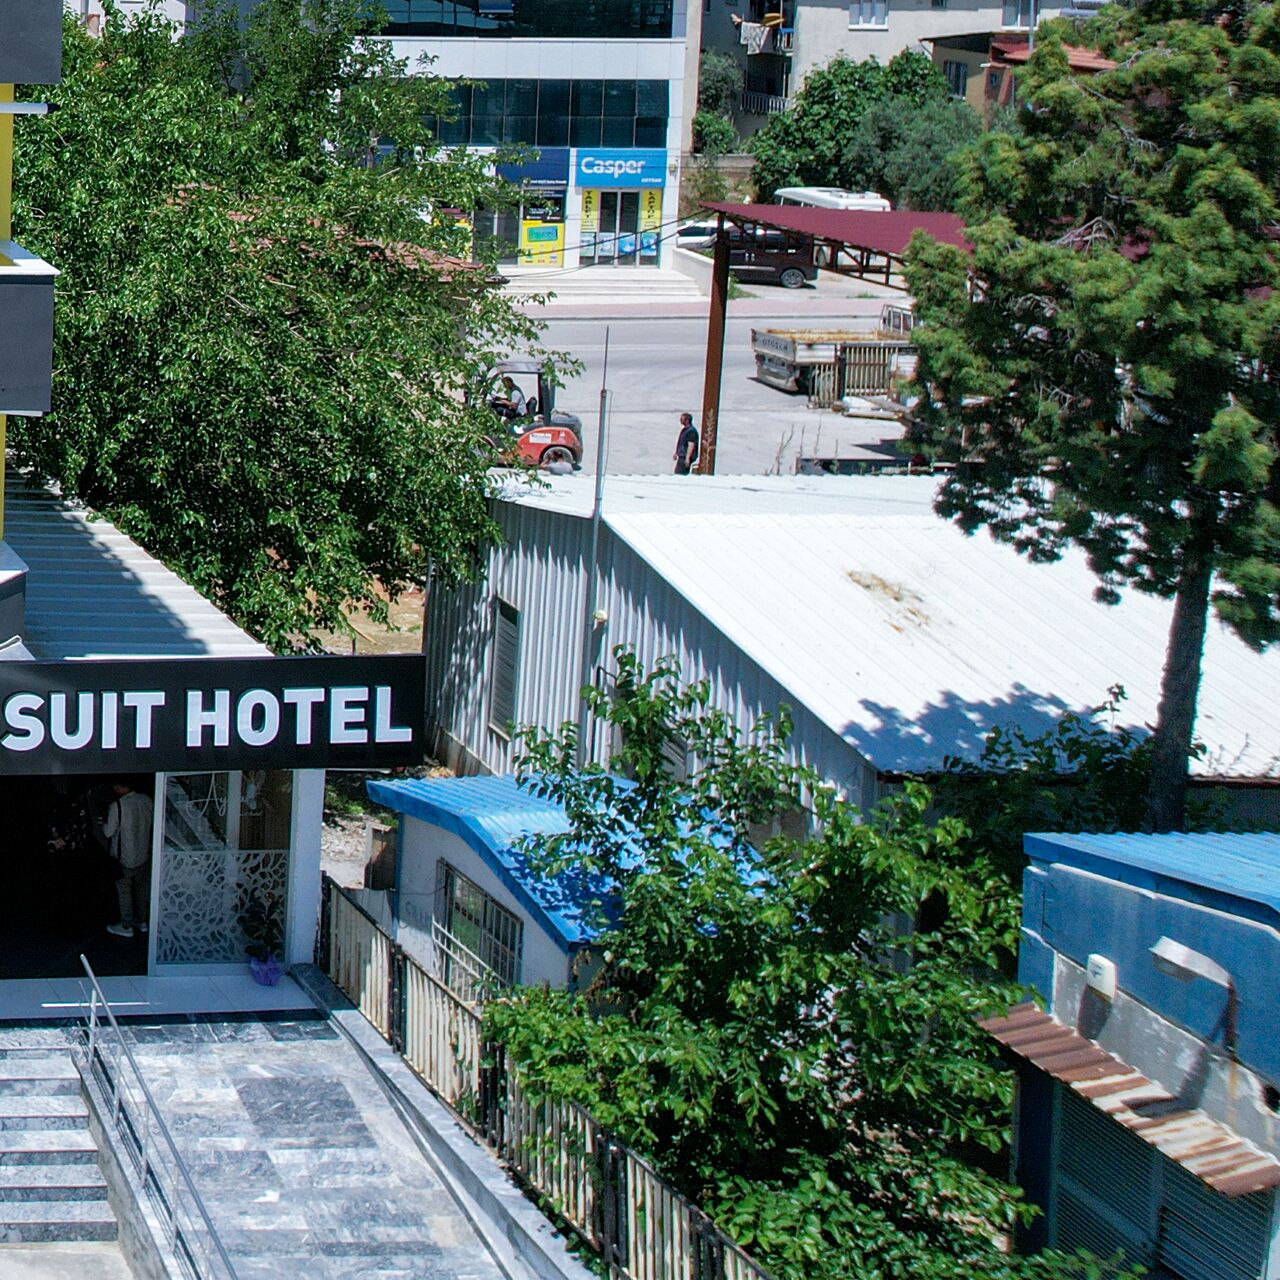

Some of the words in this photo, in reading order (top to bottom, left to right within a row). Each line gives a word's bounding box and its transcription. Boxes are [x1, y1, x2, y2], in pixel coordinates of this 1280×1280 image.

[581, 157, 646, 179] Casper
[2, 692, 165, 751] SUIT
[186, 686, 413, 748] HOTEL
